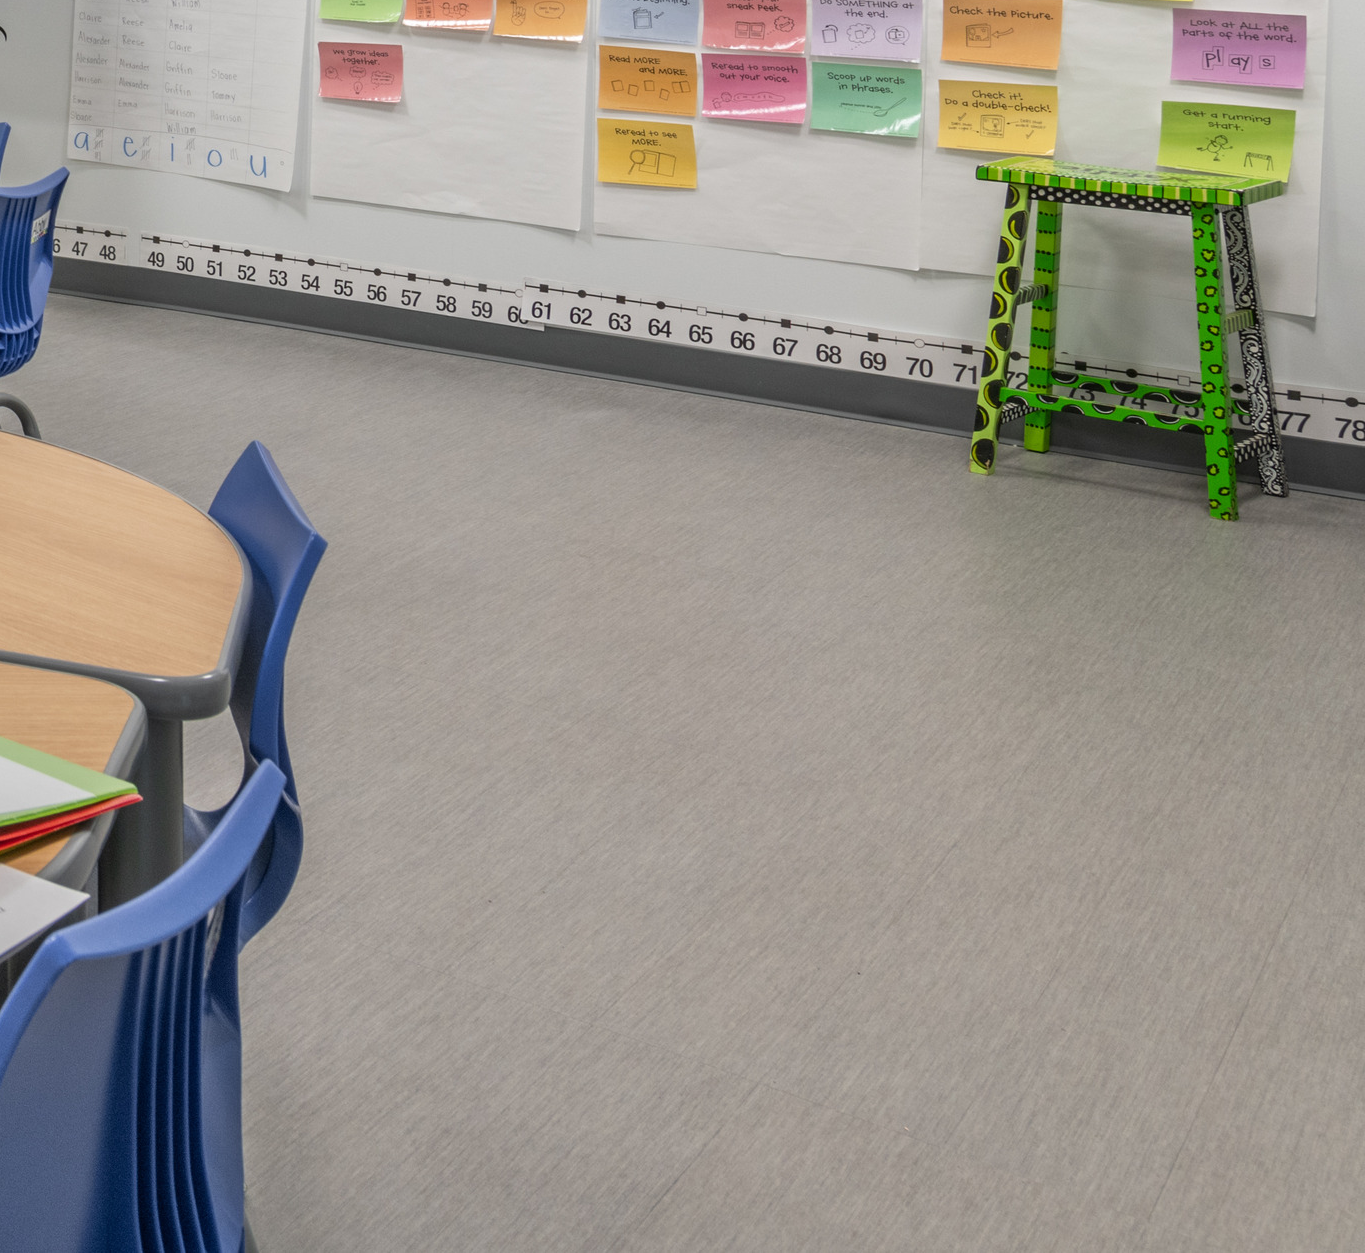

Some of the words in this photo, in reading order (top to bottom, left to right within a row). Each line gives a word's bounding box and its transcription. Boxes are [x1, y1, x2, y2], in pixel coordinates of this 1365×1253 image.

[836, 0, 898, 8] SOMETHING
[844, 9, 865, 17] the
[868, 10, 888, 18] end.
[609, 55, 631, 64] Read
[634, 56, 661, 65] MORE
[639, 66, 656, 75] and
[658, 67, 688, 77] MORE.
[1183, 109, 1206, 118] Get
[1222, 113, 1271, 126] running
[1208, 121, 1243, 132] start.
[147, 251, 165, 268] 49
[237, 264, 256, 282] 52
[400, 290, 421, 307] 57
[569, 307, 593, 326] 62
[730, 331, 755, 350] 66
[905, 357, 934, 378] 70
